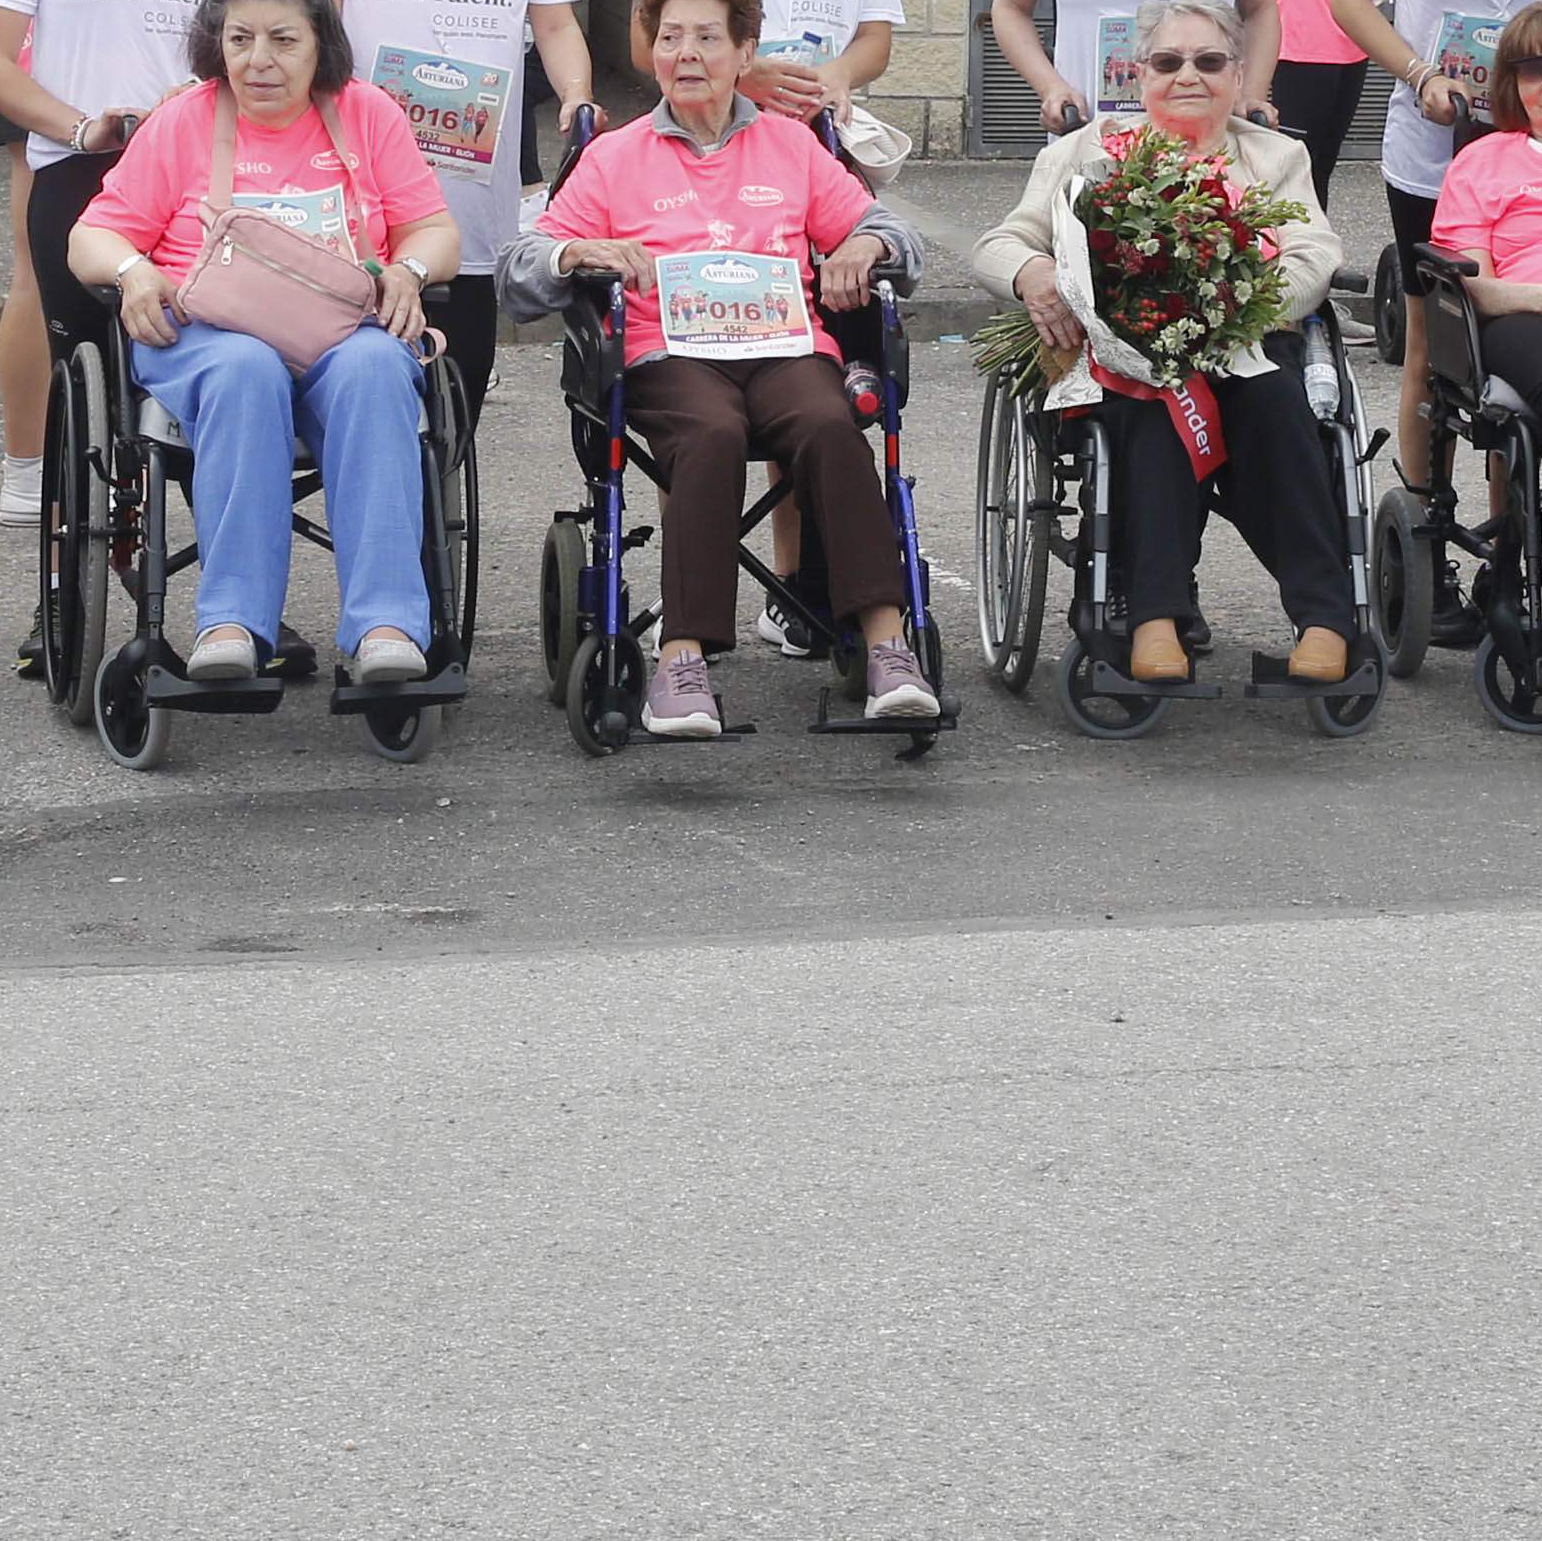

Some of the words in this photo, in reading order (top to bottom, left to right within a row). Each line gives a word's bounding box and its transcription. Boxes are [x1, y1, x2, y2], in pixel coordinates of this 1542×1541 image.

[432, 14, 499, 29] COLISEE
[414, 67, 465, 88] ASTURIANA
[409, 104, 459, 130] 016
[416, 130, 441, 142] 4532
[235, 161, 272, 175] SHO
[704, 266, 757, 280] ASTURIANA
[710, 302, 762, 321] 016
[723, 325, 748, 333] 4542
[1173, 386, 1211, 456] ander
